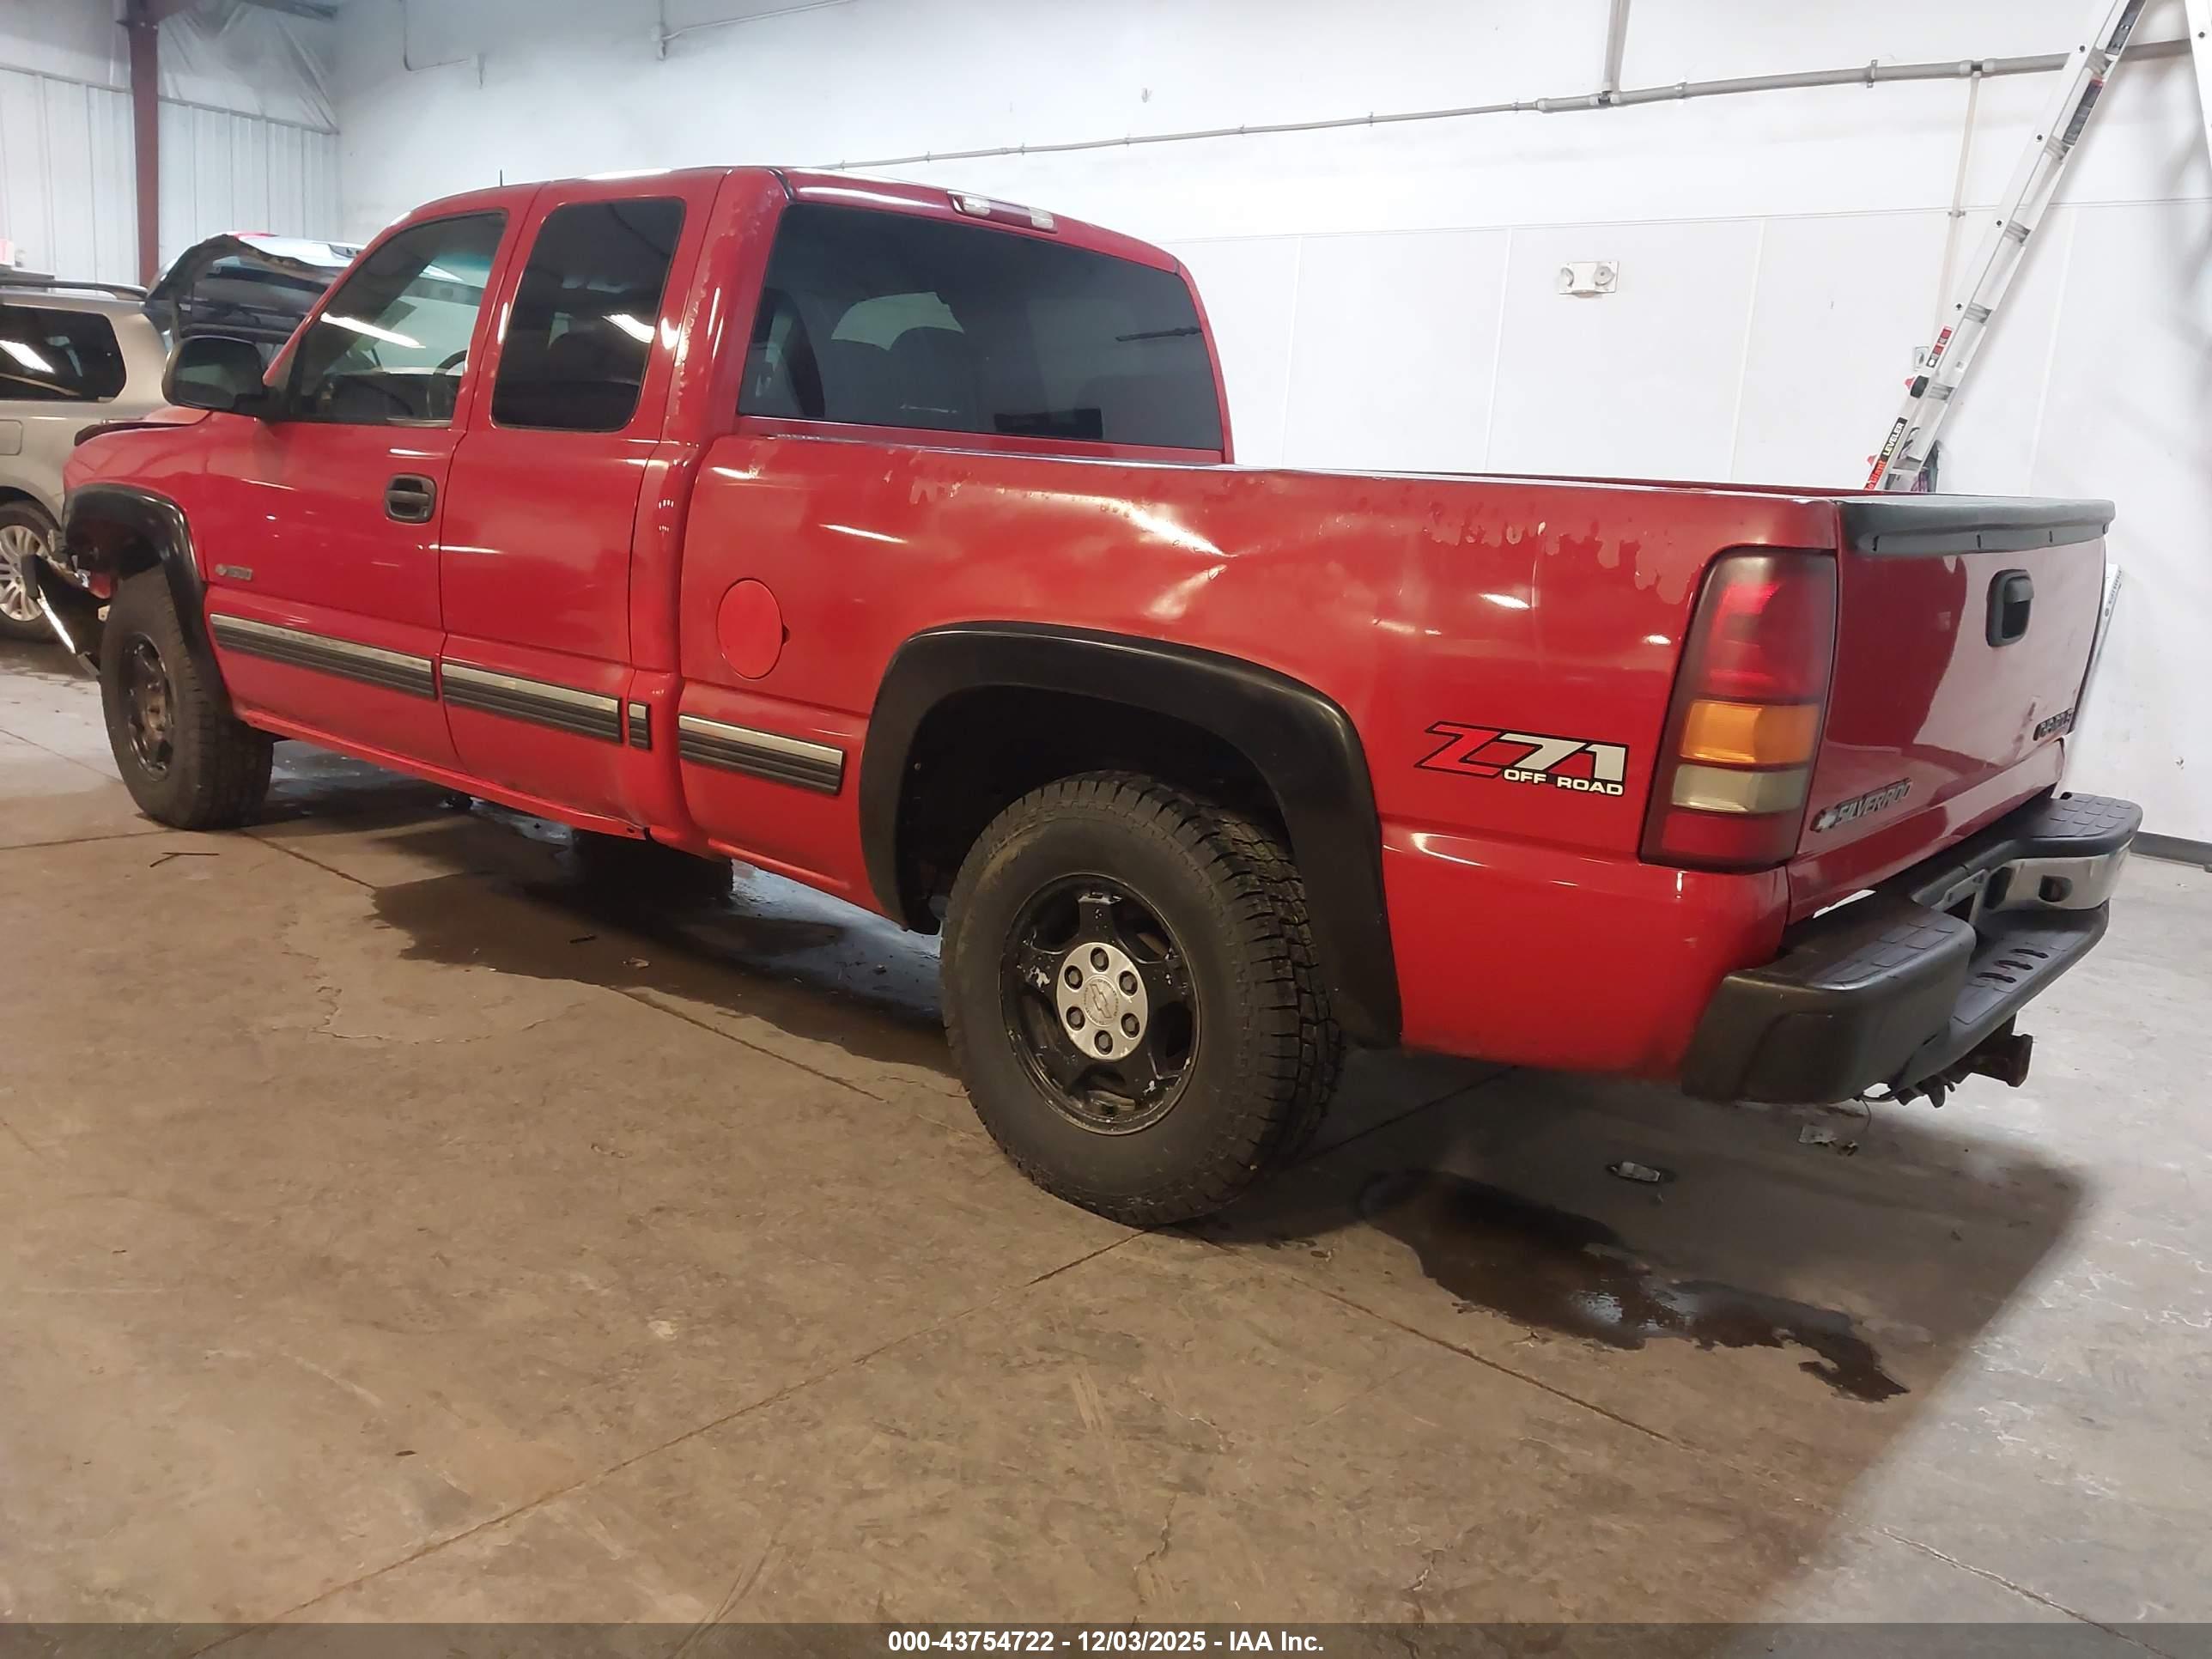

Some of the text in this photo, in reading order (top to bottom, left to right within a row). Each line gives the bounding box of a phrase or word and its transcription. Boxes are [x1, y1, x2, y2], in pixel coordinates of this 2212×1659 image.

[1882, 422, 1905, 457] LEVELER
[1414, 720, 1629, 781] Z71
[1504, 769, 1624, 796] OFF ROAD
